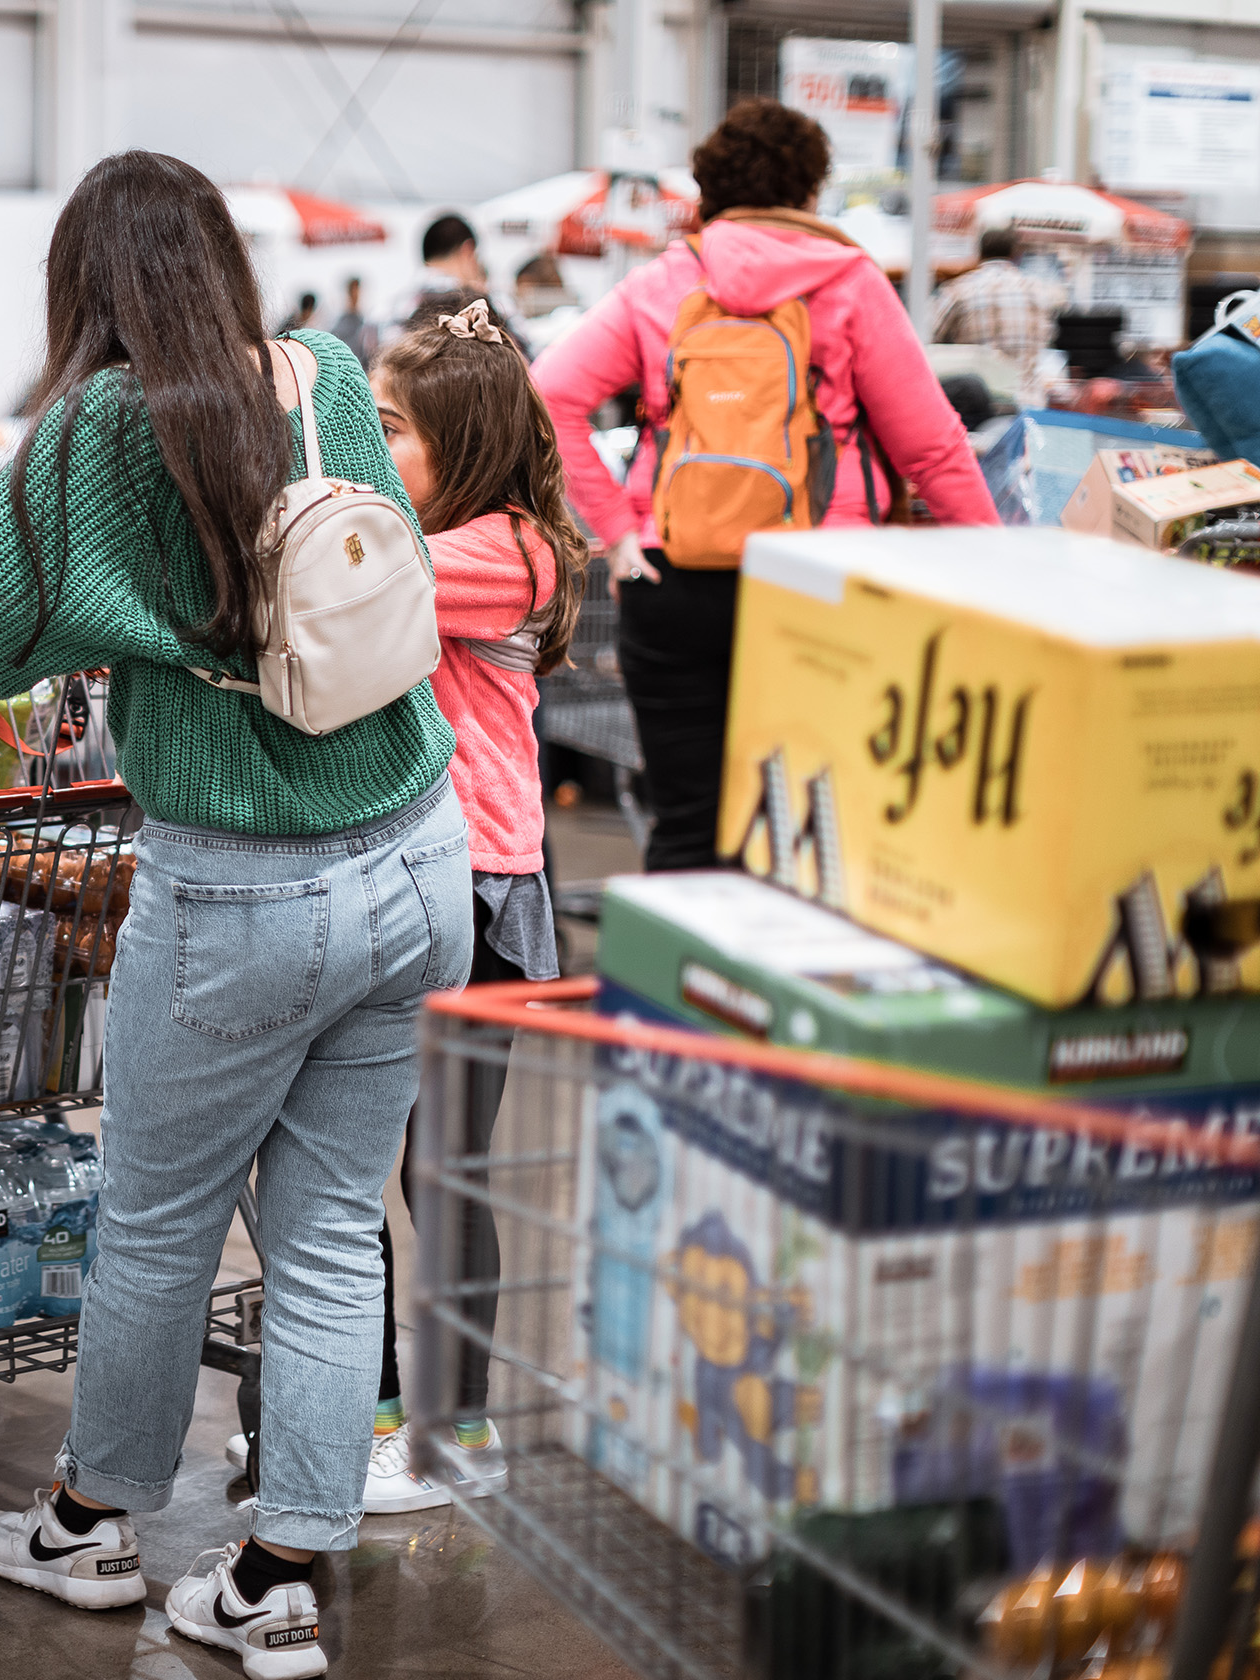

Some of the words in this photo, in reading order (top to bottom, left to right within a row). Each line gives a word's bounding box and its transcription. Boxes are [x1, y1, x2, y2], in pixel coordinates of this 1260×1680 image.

[867, 625, 1042, 828] Hefe
[100, 1561, 120, 1573] JUST
[121, 1559, 133, 1570] DO
[268, 1632, 290, 1646] JUST
[290, 1629, 305, 1641] DO
